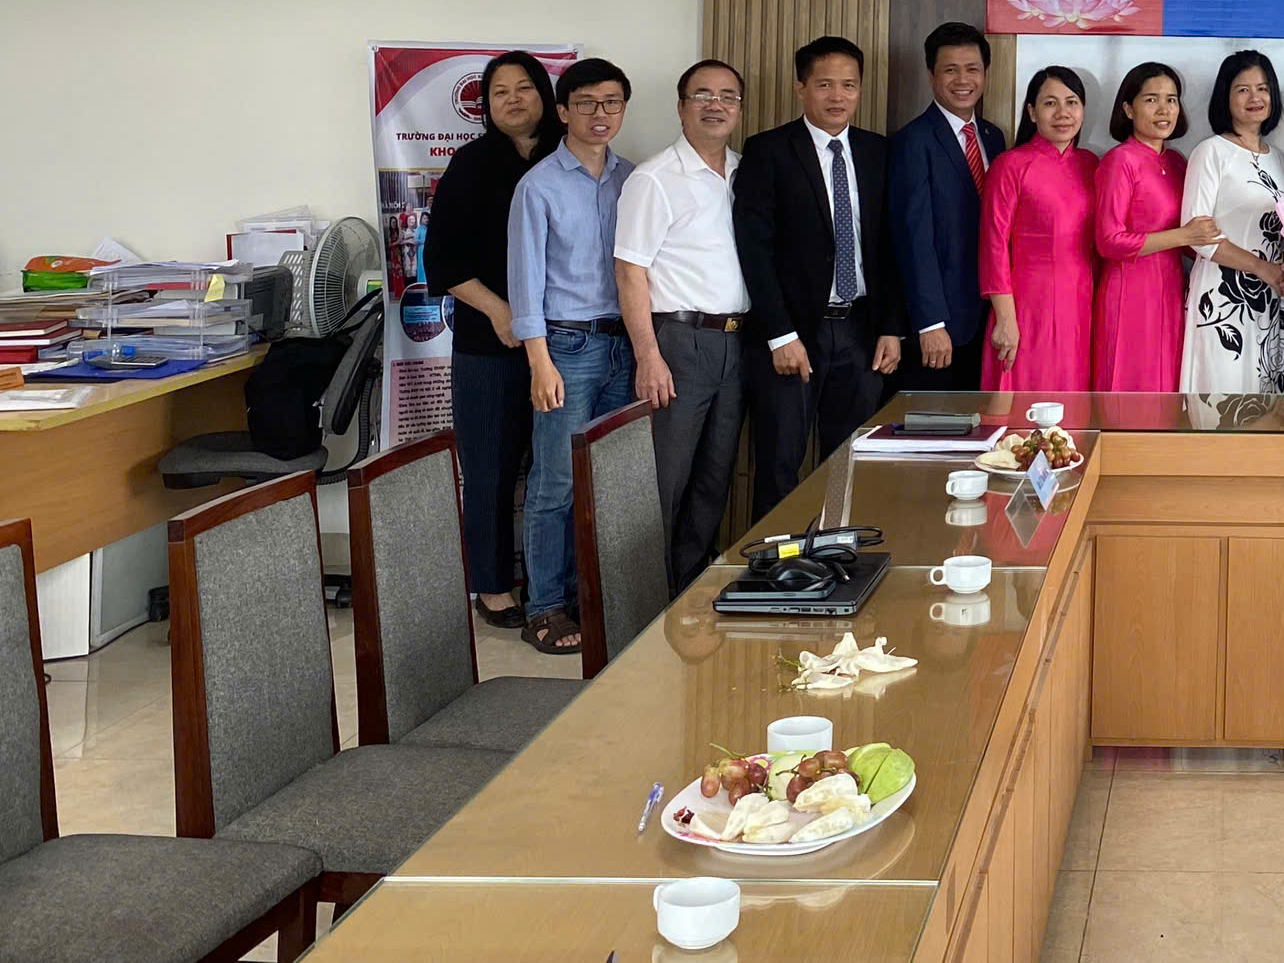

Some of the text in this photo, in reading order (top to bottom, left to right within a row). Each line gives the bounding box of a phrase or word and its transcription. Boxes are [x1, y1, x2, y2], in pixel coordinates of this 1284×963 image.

[396, 131, 436, 141] TRƯỜNG
[438, 133, 454, 142] ĐẠI
[456, 132, 476, 142] HỌC
[430, 147, 456, 157] KHO
